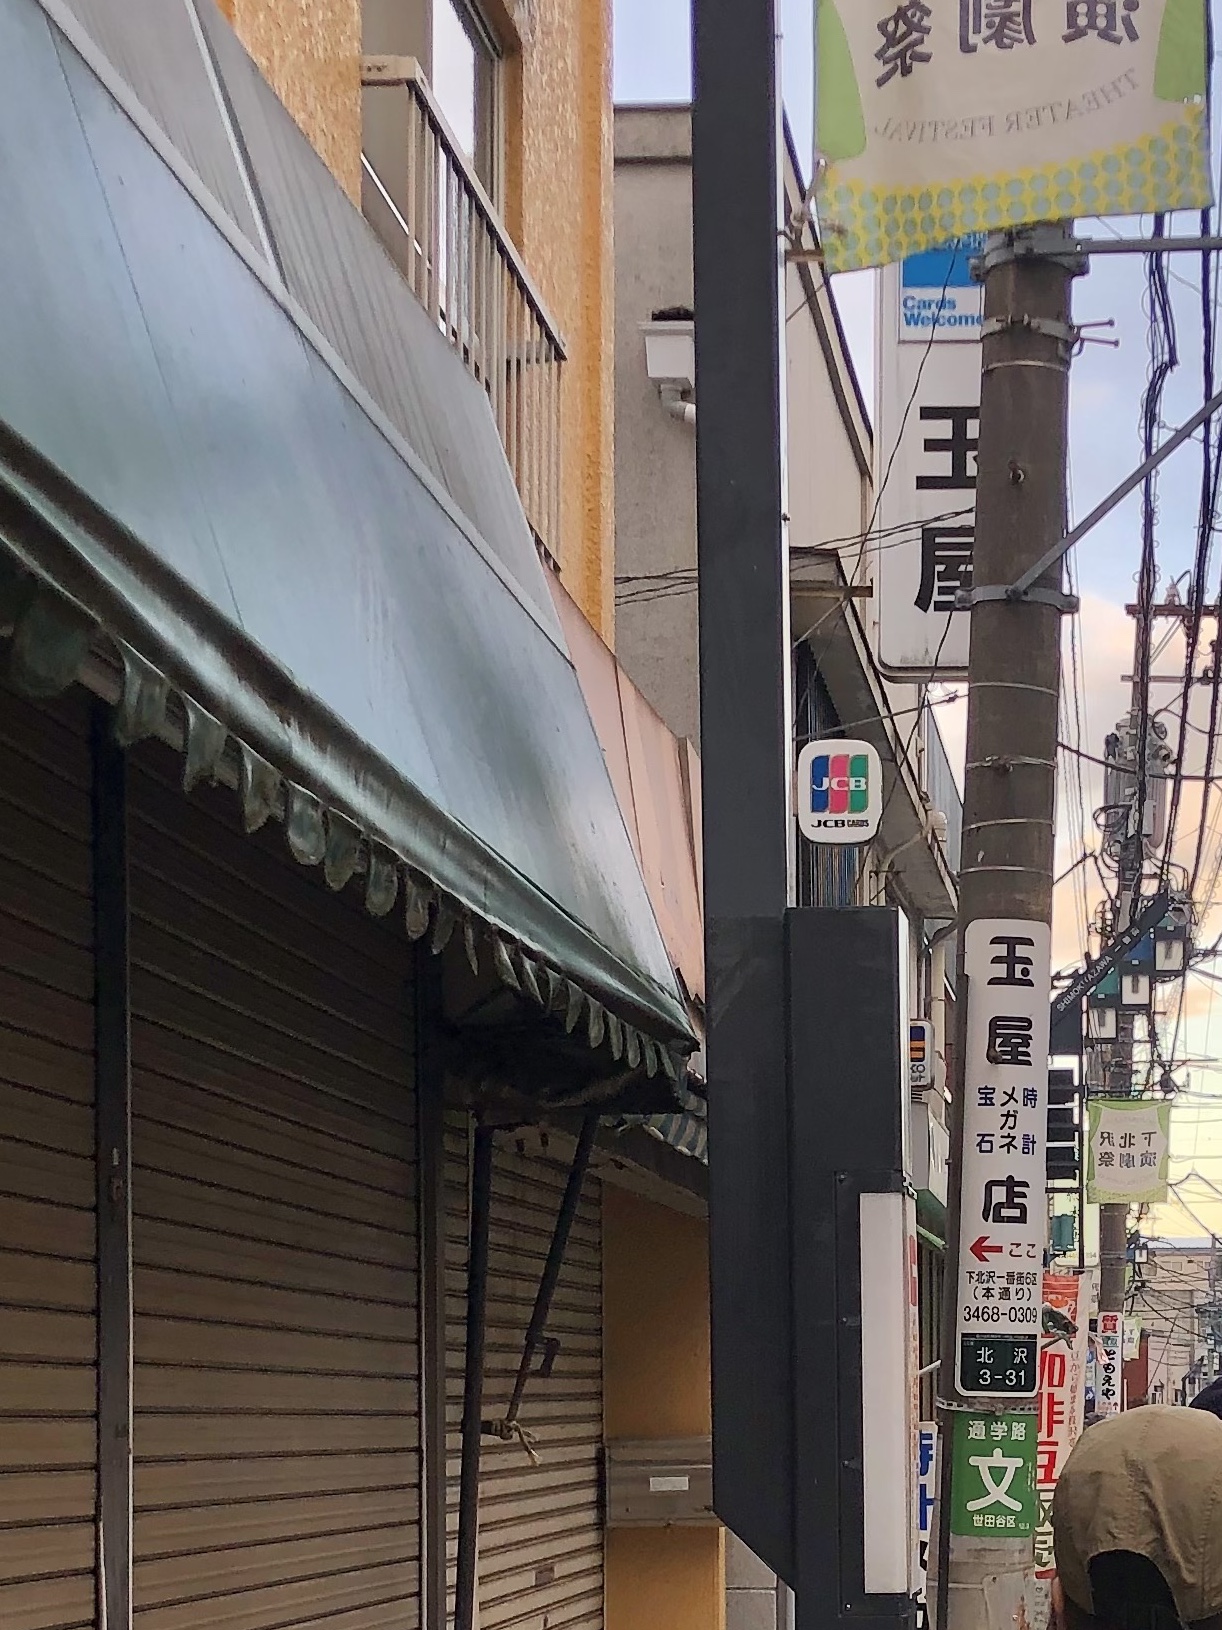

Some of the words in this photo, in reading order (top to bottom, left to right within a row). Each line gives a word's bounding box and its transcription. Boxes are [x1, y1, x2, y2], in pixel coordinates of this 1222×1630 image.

[903, 295, 957, 311] Cards
[812, 776, 867, 791] JCB
[811, 819, 846, 828] JCB
[986, 935, 1036, 1067] 玉屋
[975, 1086, 997, 1155] 宝石
[998, 1087, 1020, 1155] メガネ
[1021, 1087, 1038, 1156] 時計
[981, 1175, 1031, 1225] 店
[1009, 1242, 1037, 1259] ここ
[963, 1305, 1038, 1323] 3468-0309
[976, 1346, 1028, 1365] 北沢
[978, 1368, 1027, 1386] 3-31
[967, 1420, 1027, 1441] 通学路
[972, 1513, 1016, 1528] 世田谷区
